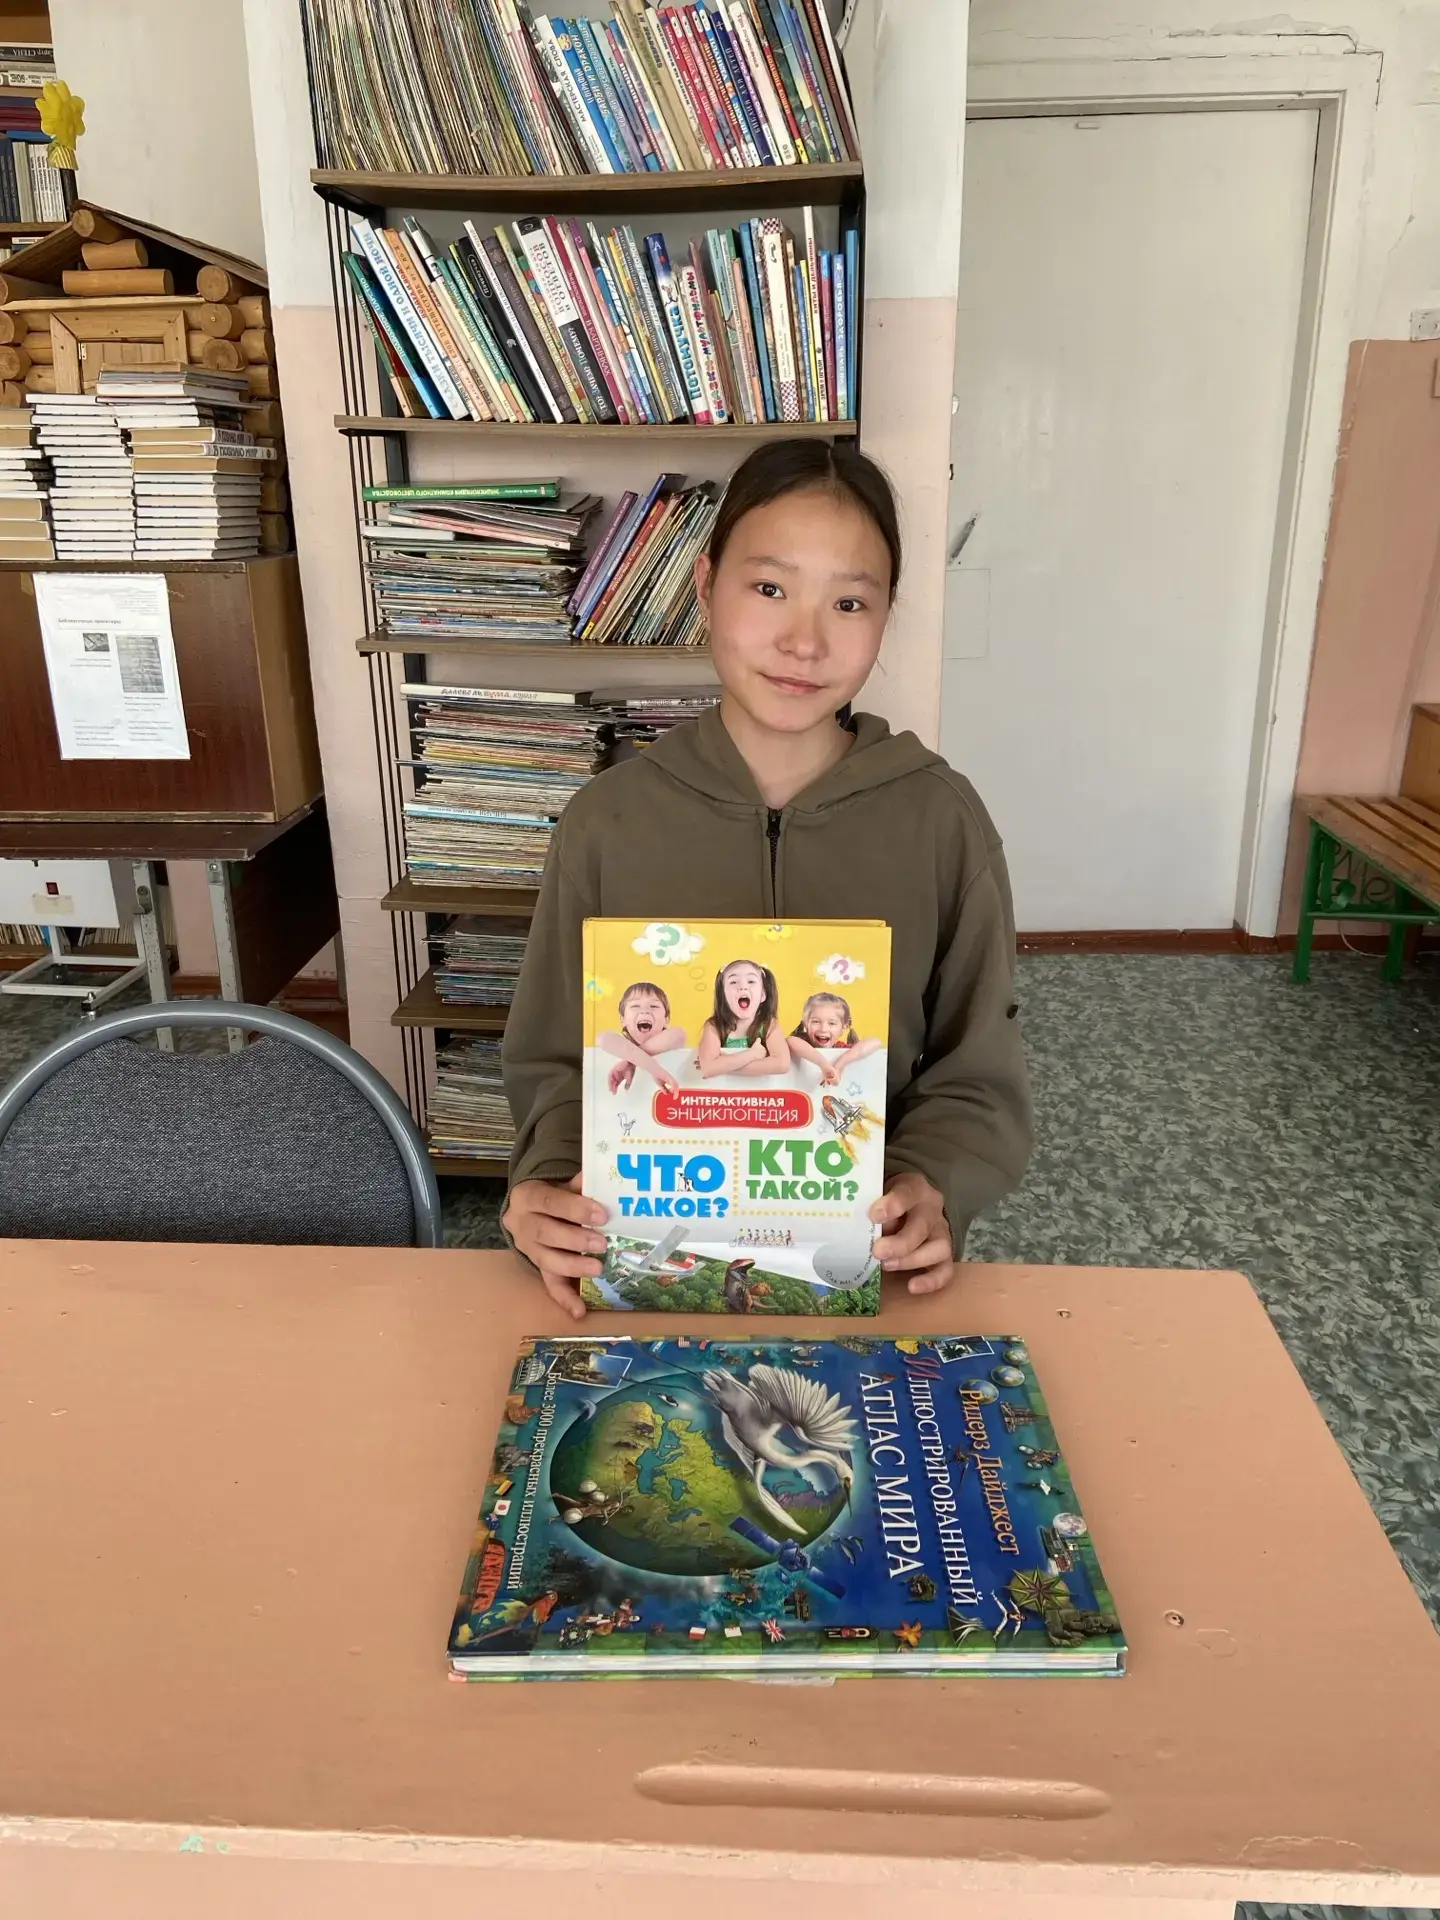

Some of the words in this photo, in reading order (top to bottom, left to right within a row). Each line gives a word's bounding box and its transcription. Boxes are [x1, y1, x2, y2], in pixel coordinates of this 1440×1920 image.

[545, 38, 564, 67] СЛОВА
[569, 31, 593, 72] ДРАКОН
[707, 36, 730, 81] ПЛАНЕТА
[724, 46, 740, 74] ДЕТЕЙ
[559, 69, 587, 123] МАСТЕРСКАЯ
[590, 83, 611, 117] БАРБИ
[735, 77, 748, 95] ДЛЯ
[743, 98, 761, 134] БИБЛИЯ
[360, 230, 386, 266] НОЧИ
[806, 237, 817, 282] ДЕЛЬФИНЫ
[376, 264, 407, 306] ОДНОЙ
[532, 243, 565, 314] ВОПРОСОВ
[537, 241, 567, 301] ОТВЕТОВ
[358, 275, 381, 311] ЦАРСТВО
[399, 304, 412, 316] И
[413, 282, 447, 338] ПУТЕШЕСТВИЕ
[834, 281, 845, 338] ЗДОРОВЬЯ
[356, 292, 379, 338] НАСЕКОМЫЕ
[377, 310, 406, 358] ПОДВОДНОЕ
[404, 314, 437, 364] ТЫСЯЧИ
[586, 325, 612, 376] КАРТИНКАХ
[666, 303, 704, 401] Потомучка
[665, 1106, 799, 1124] ЭНЦИКЛОПЕДИЯ
[680, 1094, 785, 1108] ИНТЕРАКТИВНАЯ
[617, 1154, 726, 1192] ЧТО
[748, 1139, 855, 1178] КТО
[618, 1197, 729, 1218] ТАКОЕ?
[746, 1179, 860, 1201] ТАКОЙ?
[544, 1372, 561, 1401] Более
[539, 1403, 556, 1426] 3000
[860, 1372, 906, 1466] АТЛАС
[960, 1389, 990, 1450] Ридерз
[525, 1428, 547, 1497] прекрасных
[972, 1453, 1019, 1555] Дайджест
[507, 1500, 534, 1589] иллюстраций
[875, 1475, 924, 1578] МИРА
